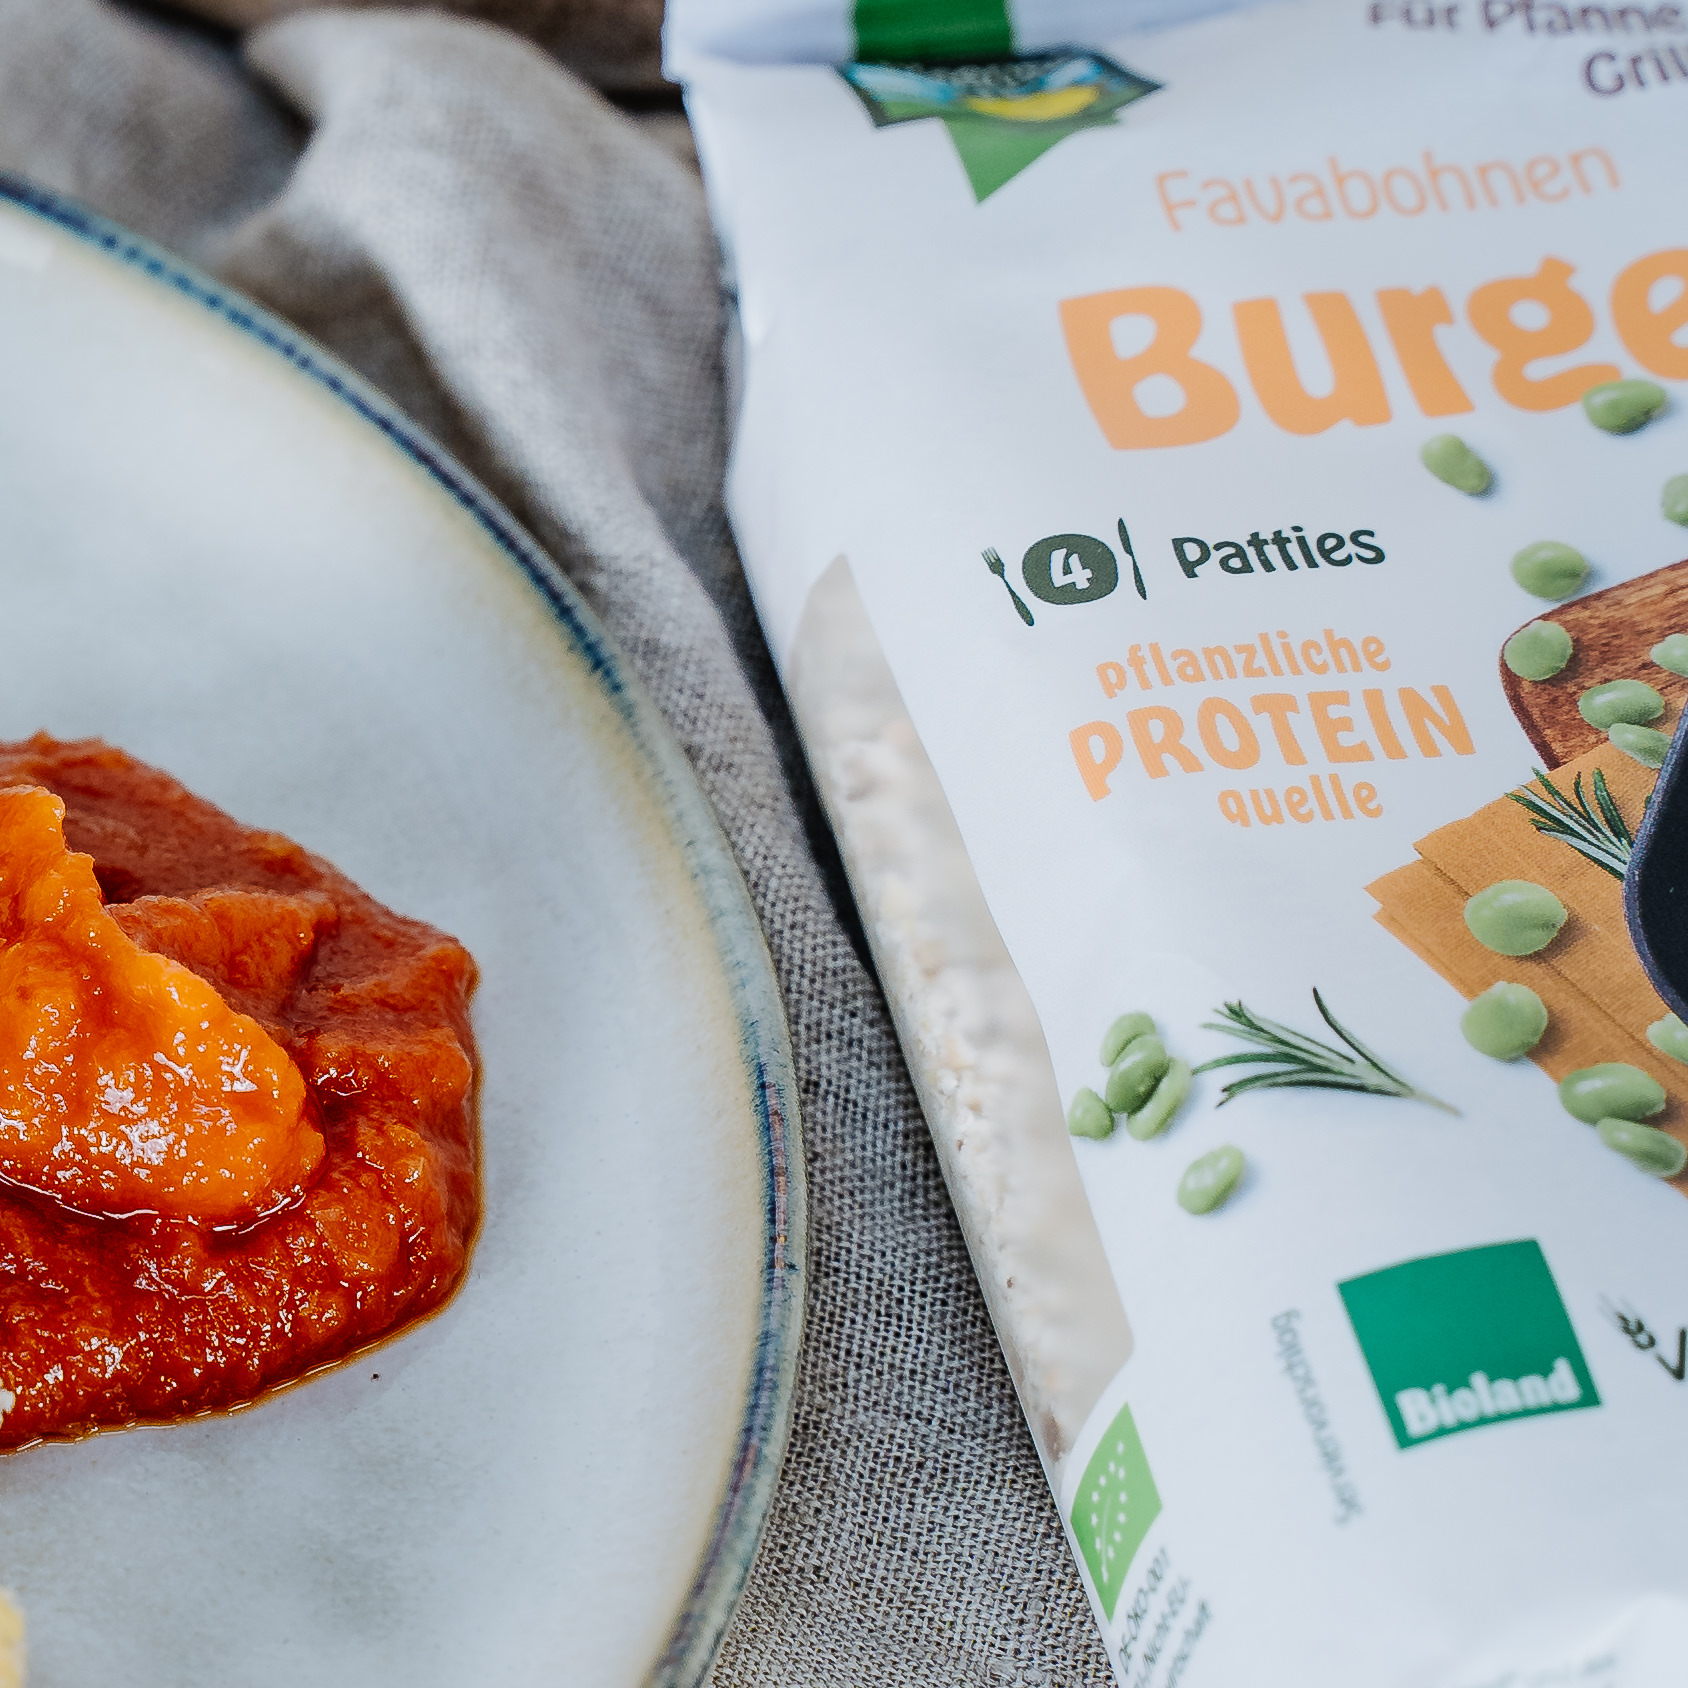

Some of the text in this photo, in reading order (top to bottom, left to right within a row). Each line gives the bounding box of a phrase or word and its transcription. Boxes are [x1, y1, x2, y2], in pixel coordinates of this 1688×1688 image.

[1154, 147, 1618, 231] Favabohnen
[1048, 525, 1387, 591] 4 Patties
[1095, 628, 1392, 699] pflanzliche
[1068, 684, 1477, 802] PROTEIN
[1217, 773, 1384, 828] quelle
[1394, 1356, 1582, 1439] Bioland
